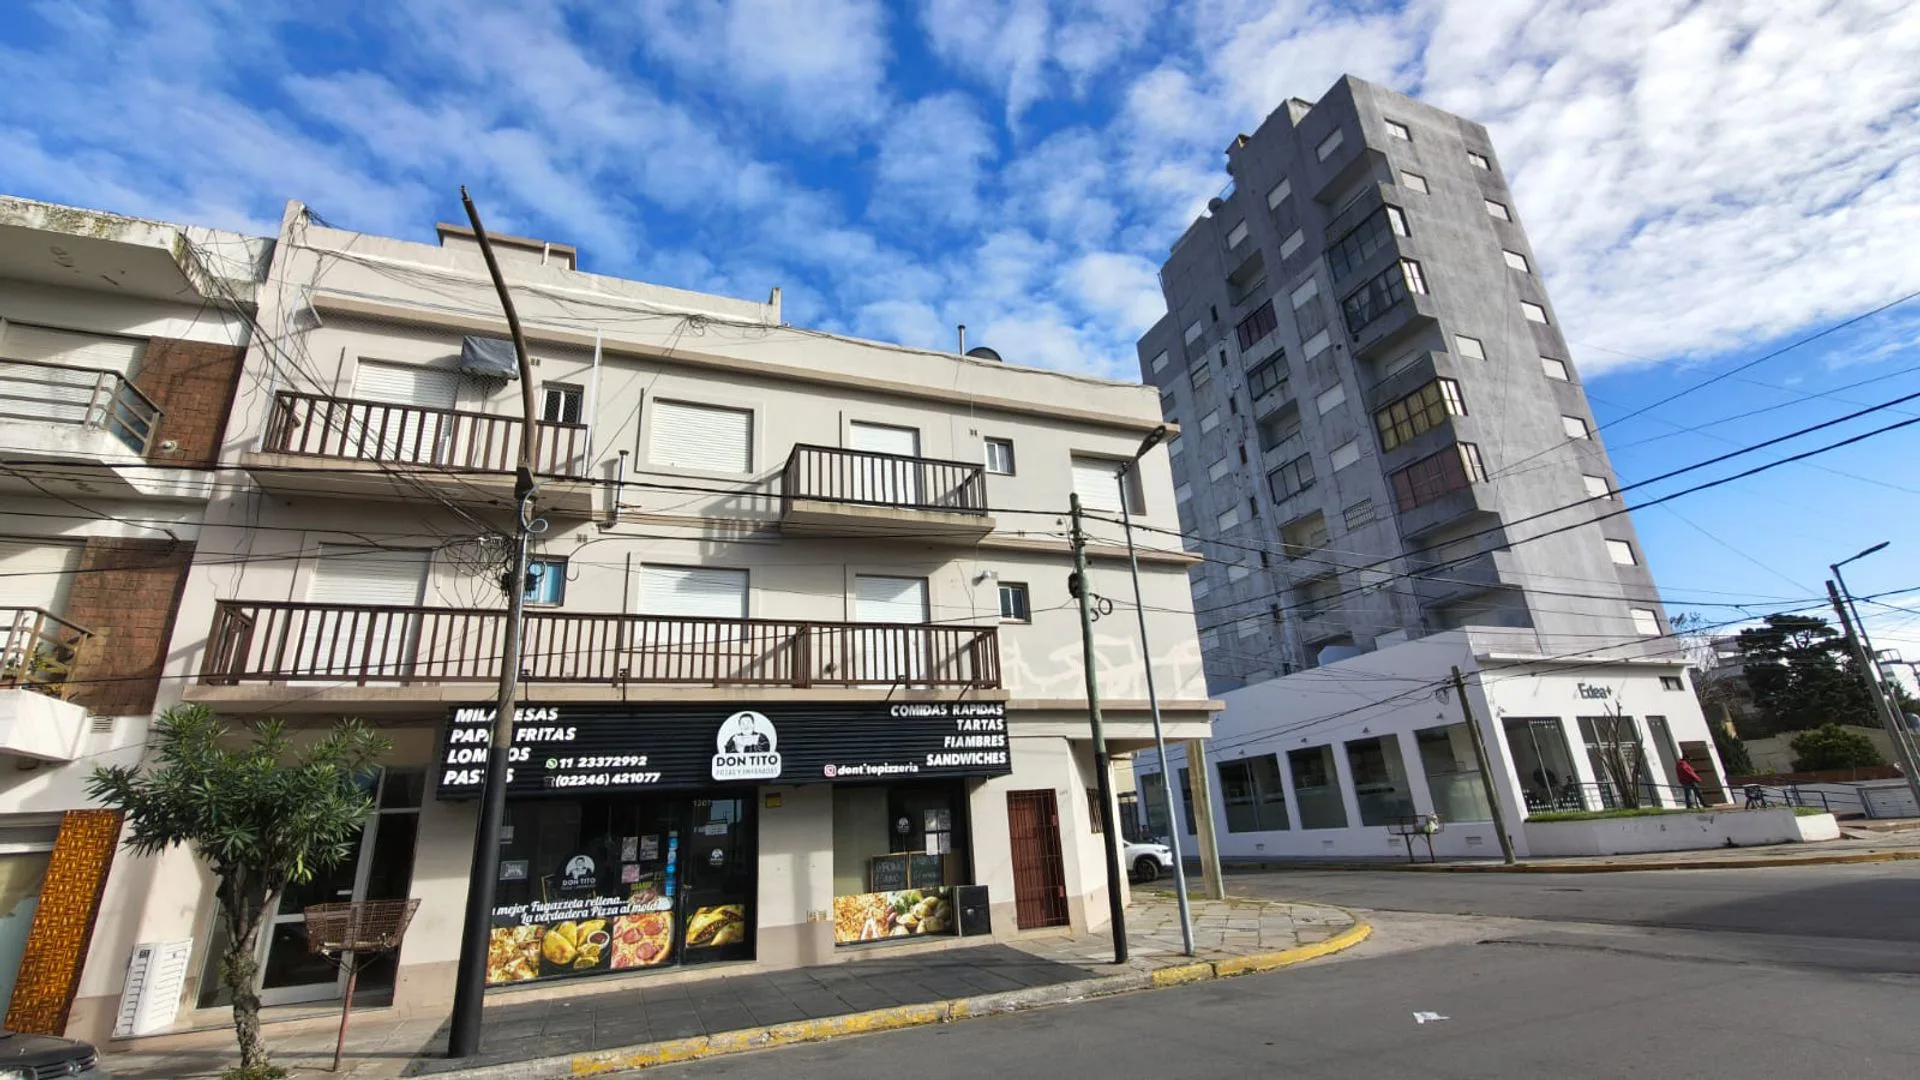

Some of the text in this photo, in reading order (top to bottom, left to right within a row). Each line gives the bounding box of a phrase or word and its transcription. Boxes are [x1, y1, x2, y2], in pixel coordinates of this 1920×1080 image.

[454, 707, 559, 723] MILAESAS
[890, 704, 1004, 717] COMIDAS RAPIDAS
[956, 719, 1004, 731] TARTAS
[515, 727, 577, 742] FRITAS
[944, 735, 1005, 748] FIAMBRES
[446, 747, 532, 764] LOMOS
[559, 755, 648, 769] 11 23372992
[716, 755, 778, 767] DON TITO
[926, 751, 1007, 766] SANDWICHES
[442, 767, 515, 785] PASS
[555, 772, 661, 788] (02246) 421077
[496, 903, 529, 918] mejor
